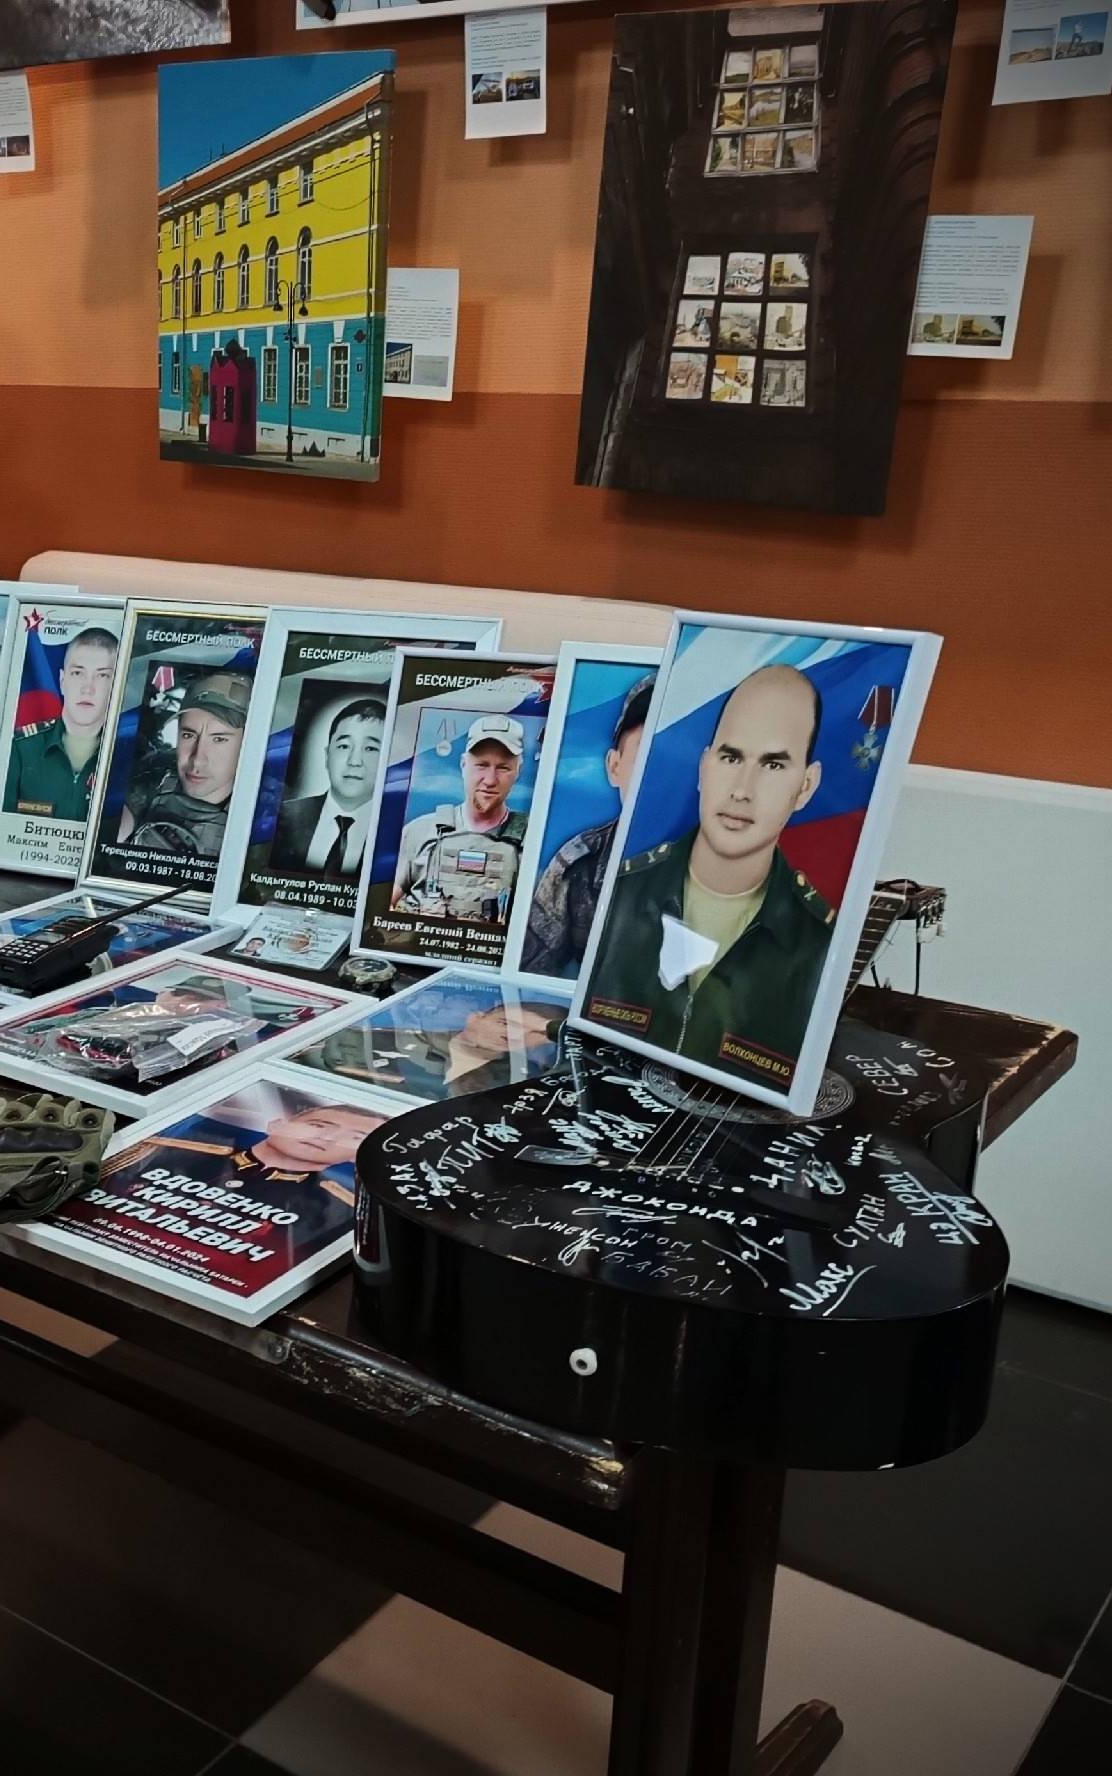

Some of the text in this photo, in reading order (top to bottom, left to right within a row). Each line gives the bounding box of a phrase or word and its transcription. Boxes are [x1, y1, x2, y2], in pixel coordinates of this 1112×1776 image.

[146, 629, 224, 647] БЕССМЕРТНЫЙ
[8, 834, 48, 849] Максим
[100, 843, 148, 860] Терещенко
[149, 850, 186, 864] Николай
[125, 861, 173, 877] 09.03.1987
[308, 880, 342, 894] Руслан
[373, 916, 412, 932] Бареев
[415, 922, 463, 939] Евгений
[844, 1054, 909, 1096] СЕВЕР
[140, 1168, 300, 1225] ВДОВЕНКО
[562, 1180, 758, 1228] ДЖОКОНДА
[132, 1187, 263, 1235] КИРИЛЛ
[833, 1193, 886, 1248] СУЛТАН
[622, 1227, 692, 1252] ГРОМ
[779, 1263, 855, 1311] Макс
